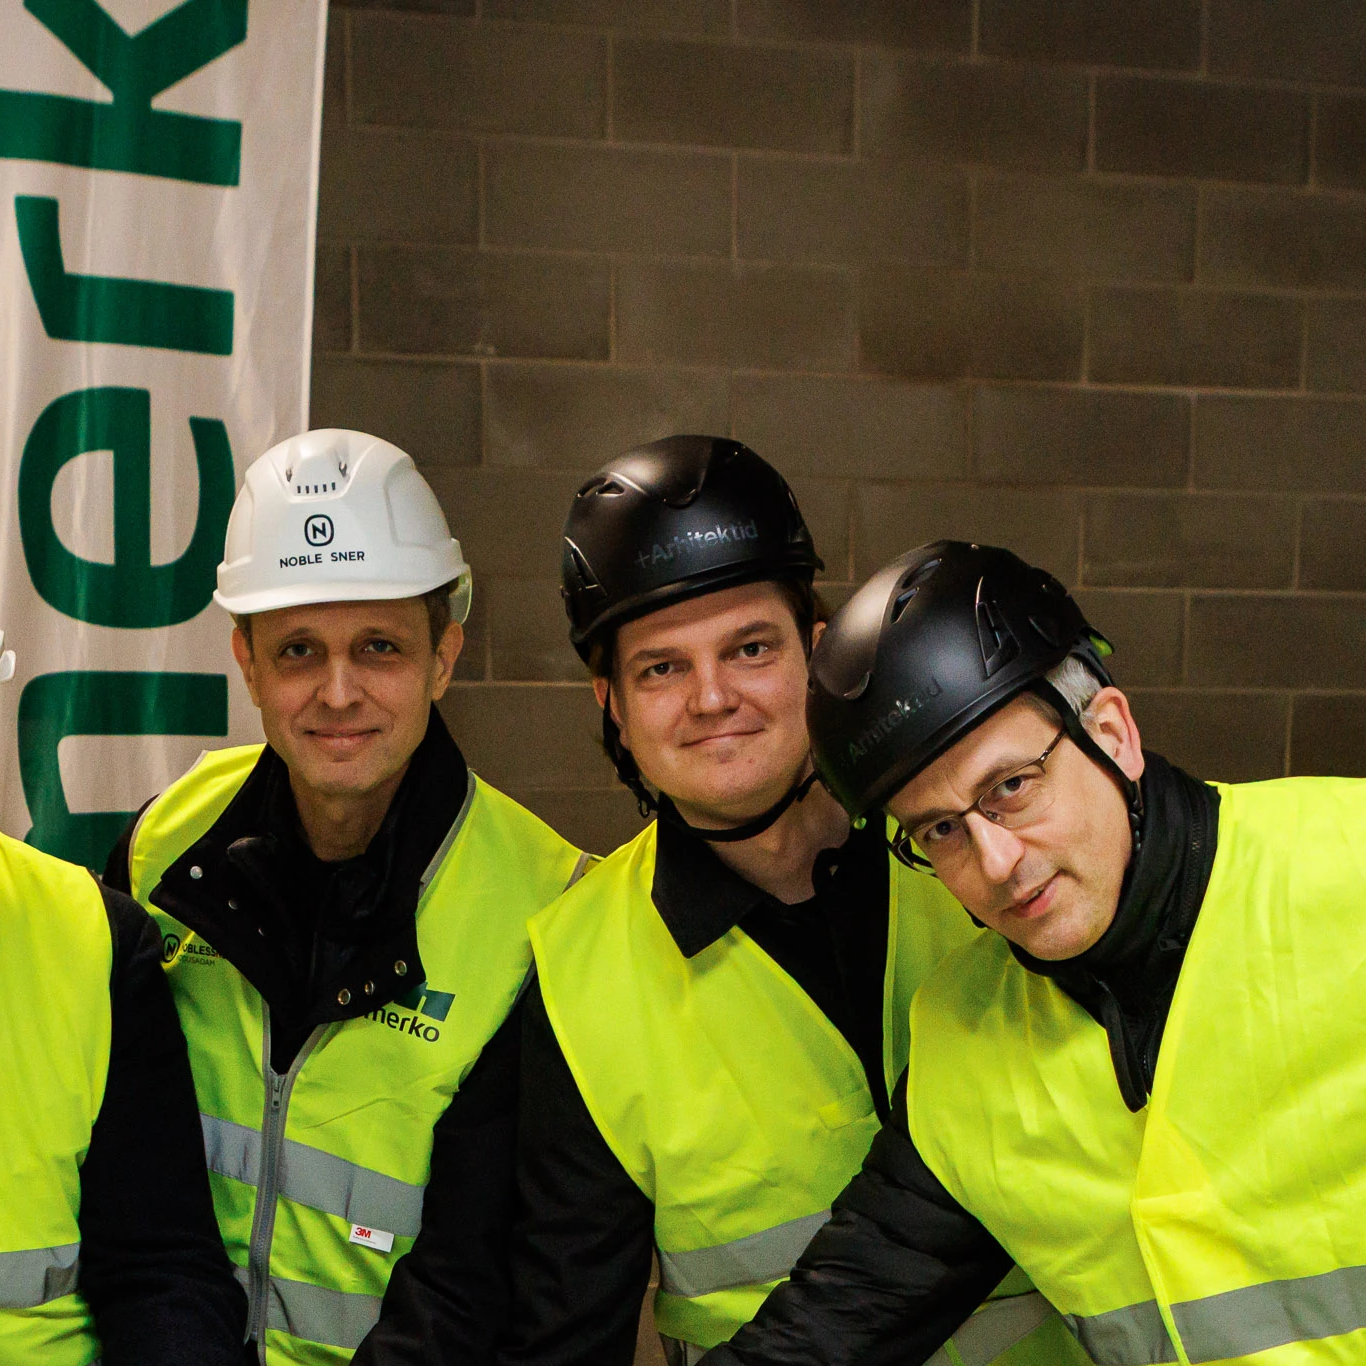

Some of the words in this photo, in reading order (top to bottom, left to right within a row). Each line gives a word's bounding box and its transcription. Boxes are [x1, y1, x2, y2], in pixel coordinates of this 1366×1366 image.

[279, 553, 323, 568] NOBLE
[330, 551, 366, 563] SNER
[355, 1227, 372, 1239] 3M
